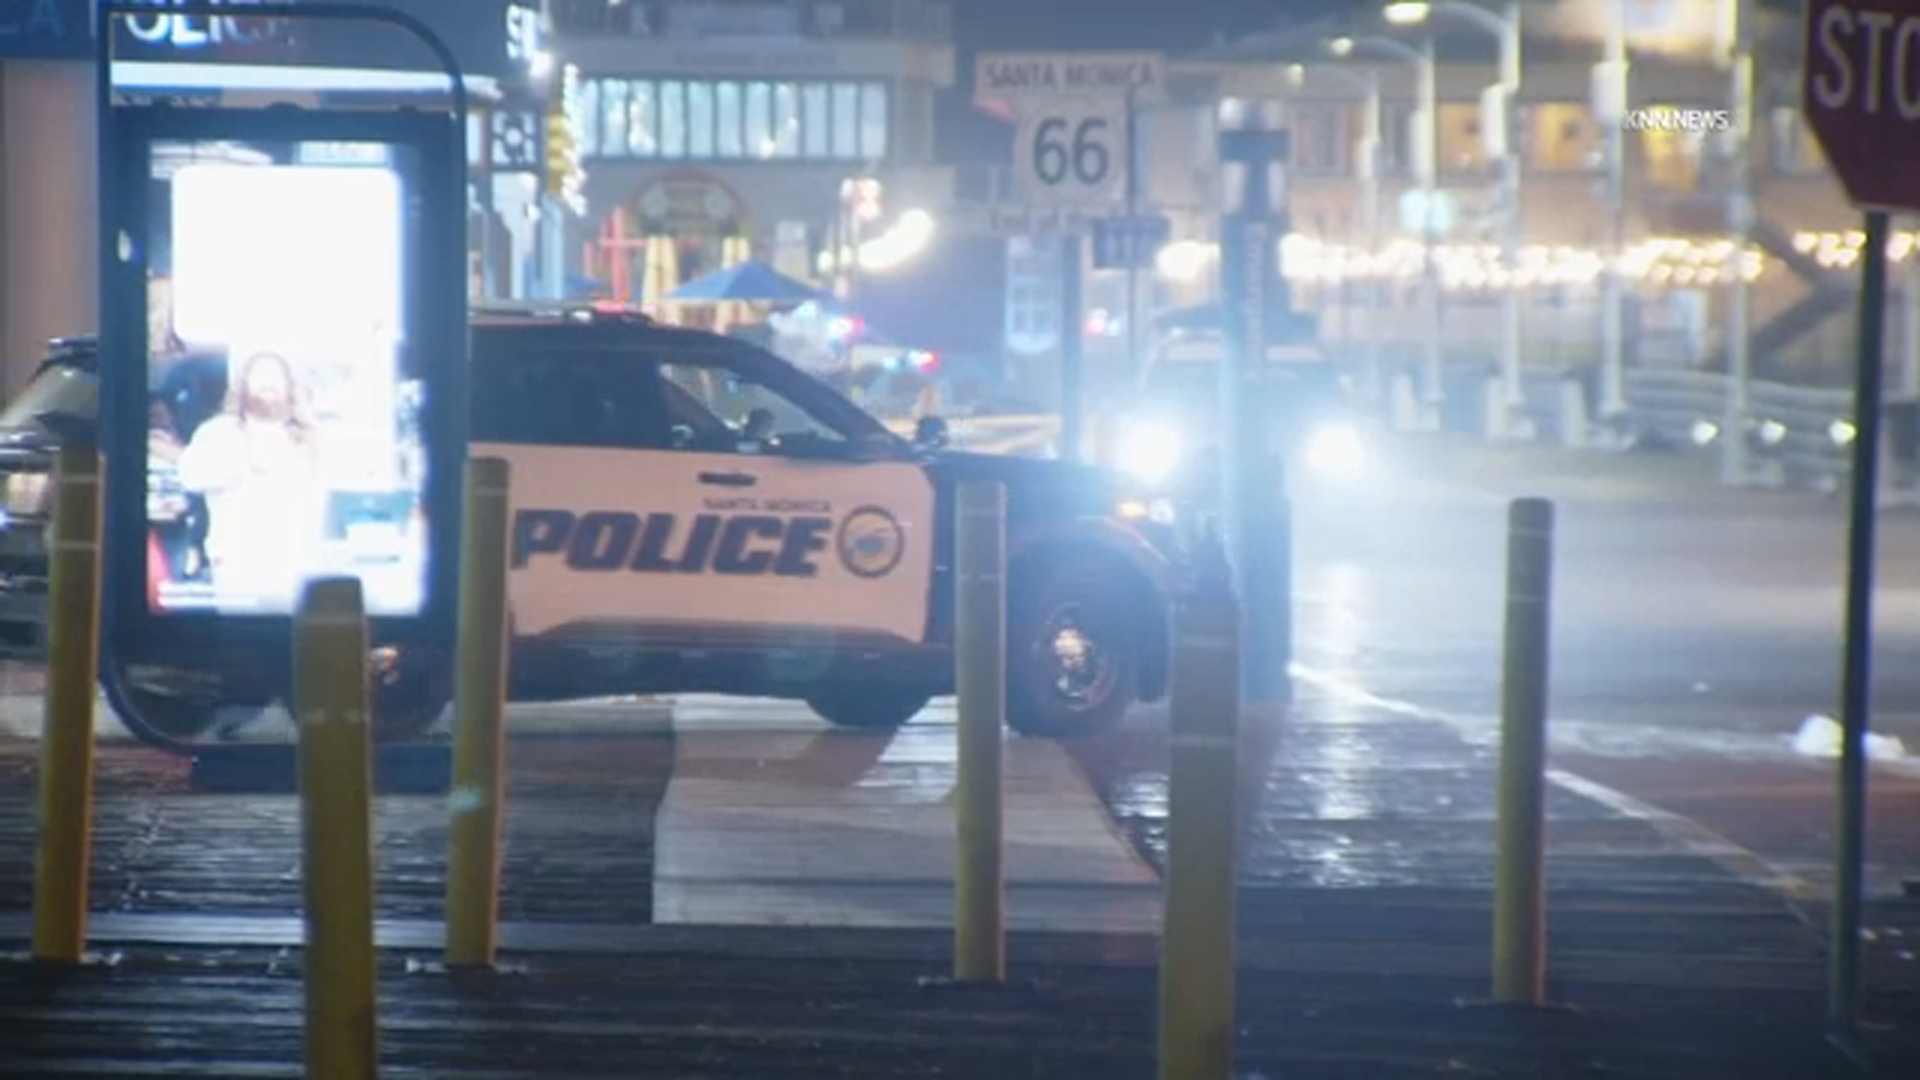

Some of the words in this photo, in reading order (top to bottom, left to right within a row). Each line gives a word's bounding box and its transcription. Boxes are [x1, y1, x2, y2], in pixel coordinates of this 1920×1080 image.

[985, 61, 1056, 89] SANTA
[1066, 60, 1155, 88] MONICA
[1033, 117, 1109, 186] 66
[510, 508, 834, 577] POLICE
